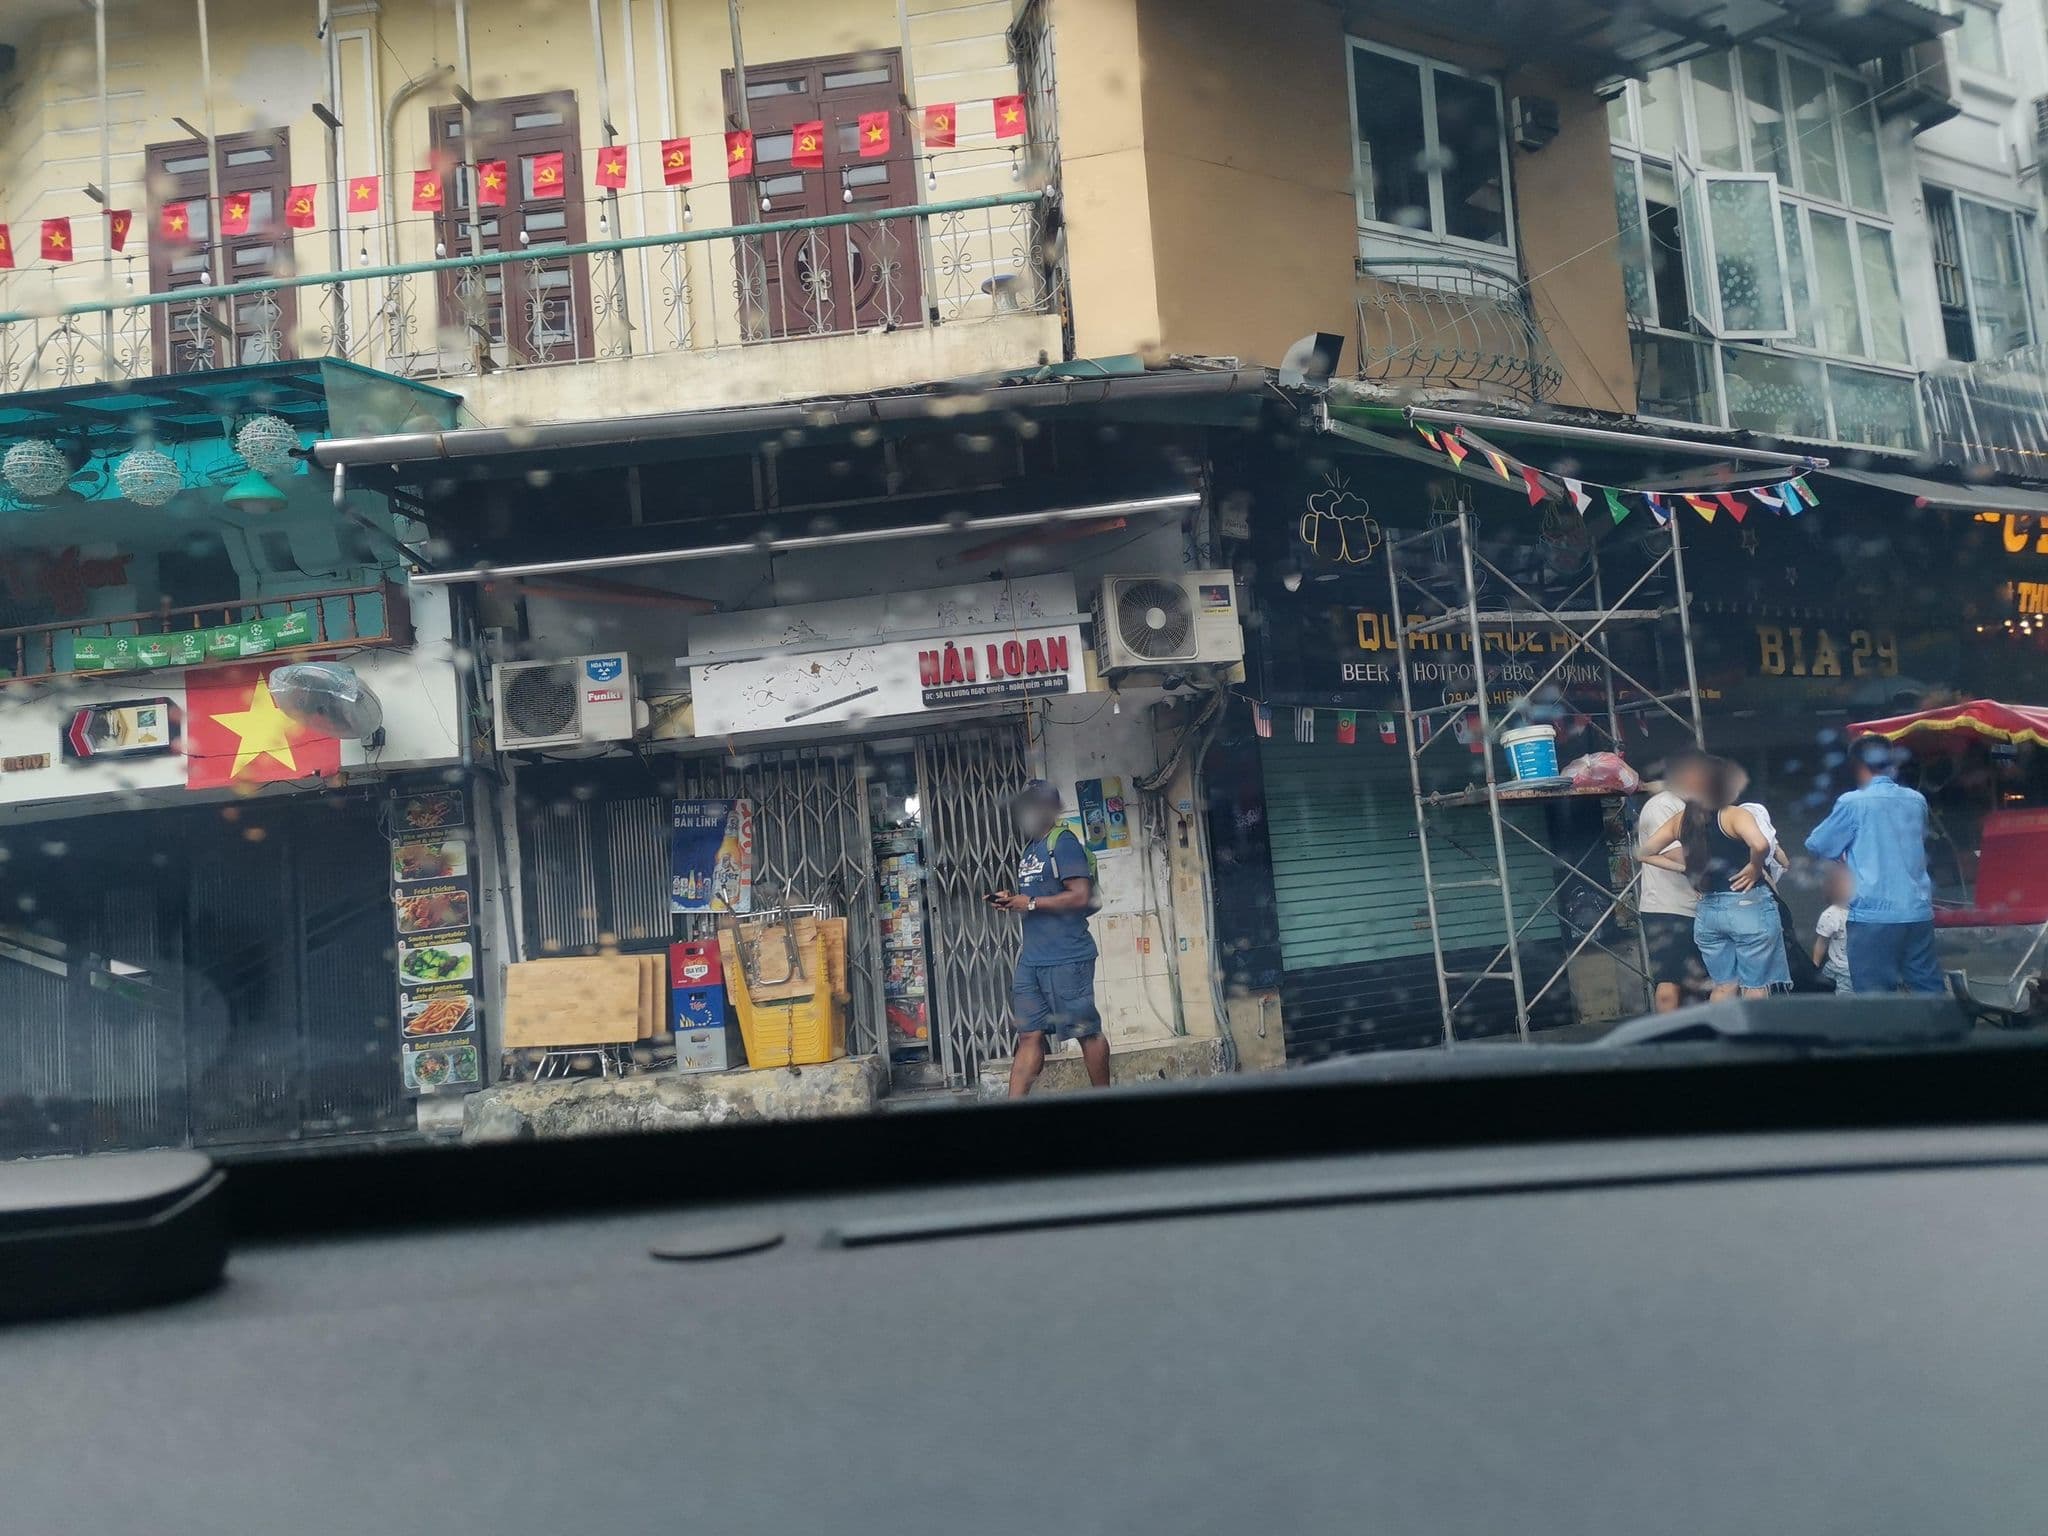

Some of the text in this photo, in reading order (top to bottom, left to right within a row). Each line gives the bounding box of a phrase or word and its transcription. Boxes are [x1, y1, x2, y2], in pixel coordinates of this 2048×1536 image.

[918, 636, 1069, 686] HẢI LOAN
[1756, 624, 1898, 676] BIA 29
[1343, 662, 1602, 682] BEER HOTPOT BBQ DRINK
[588, 690, 621, 701] Funiki
